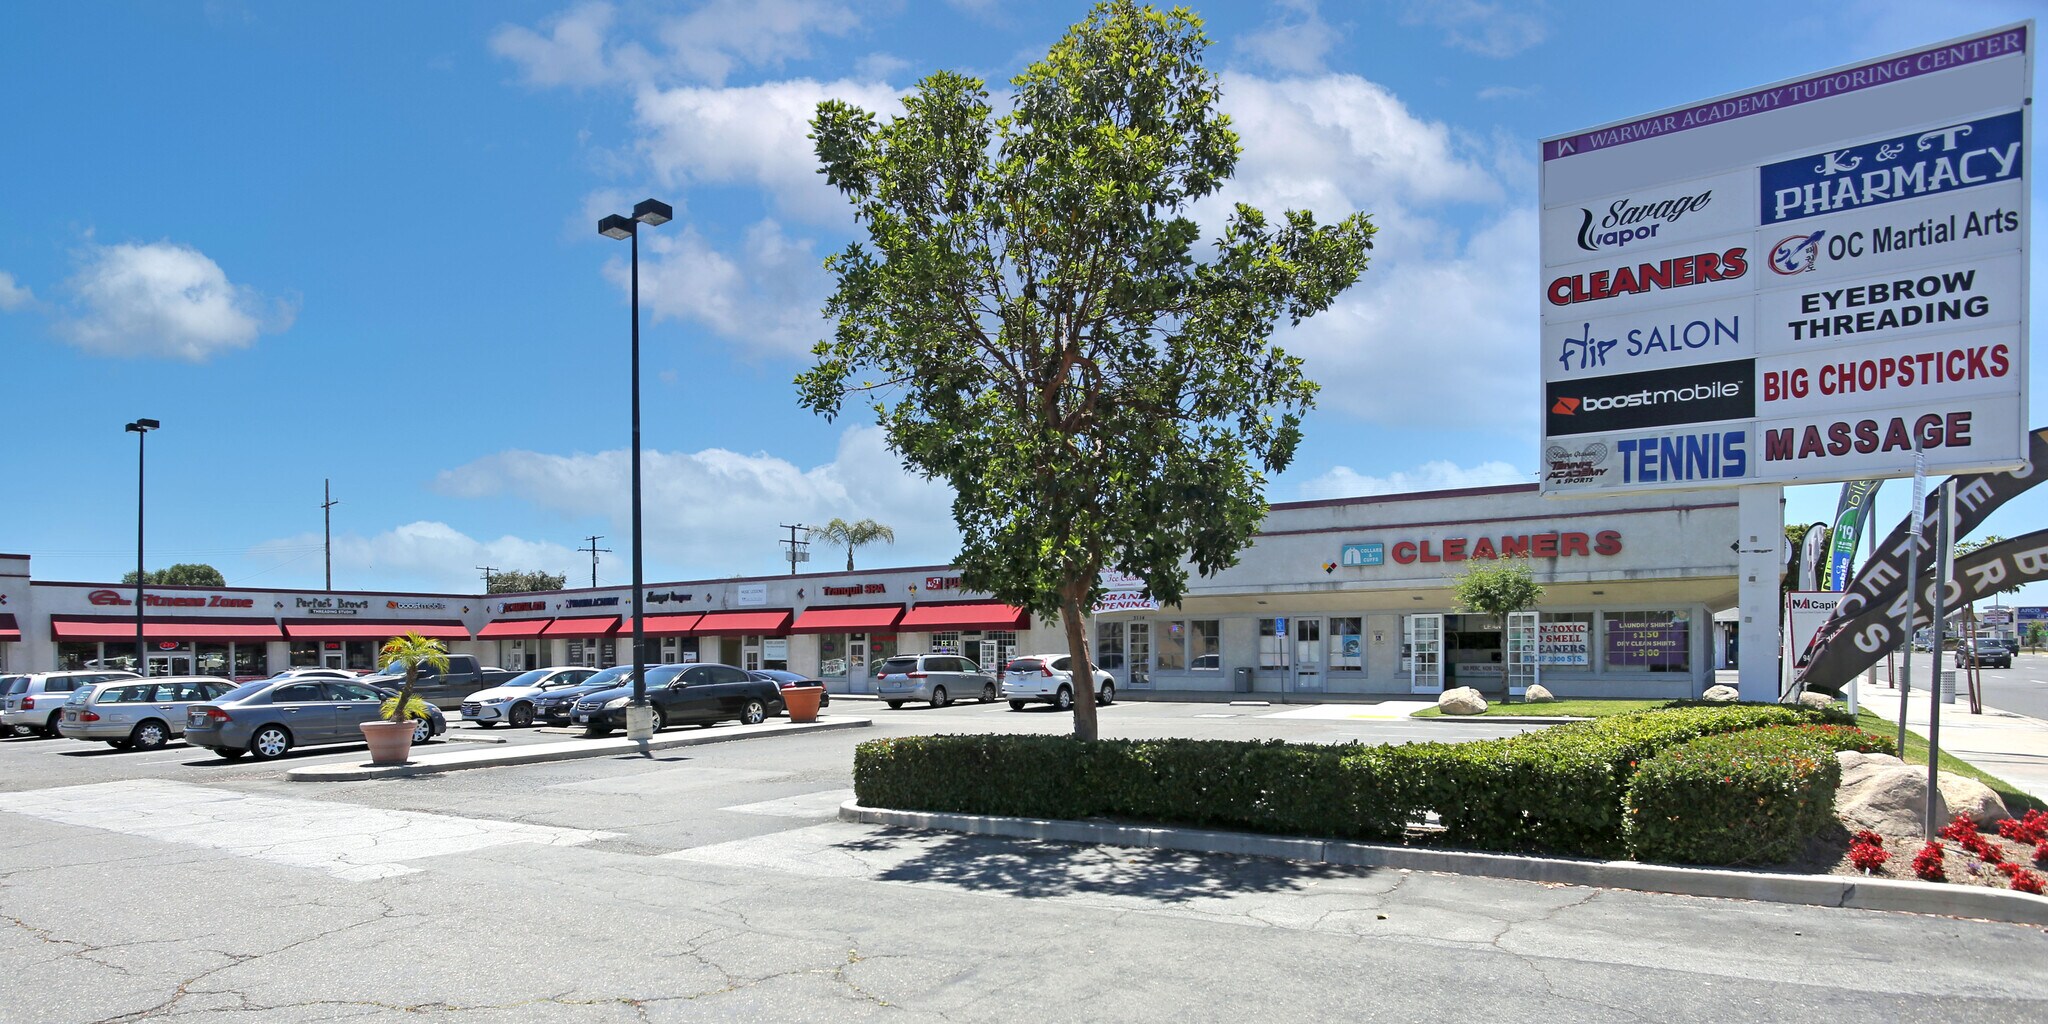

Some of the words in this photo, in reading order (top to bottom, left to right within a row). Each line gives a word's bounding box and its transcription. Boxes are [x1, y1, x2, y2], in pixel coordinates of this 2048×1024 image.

[1590, 117, 1676, 148] WARWAR
[1682, 90, 1783, 127] ACADEMY
[1789, 60, 1909, 101] TUTORING
[1917, 33, 2019, 71] CENTER
[1814, 150, 1862, 175] K
[1875, 143, 1904, 161] &
[1917, 125, 1972, 151] T
[1775, 142, 2021, 219] PHARMACY
[1602, 190, 1712, 228] Savage
[1829, 231, 1864, 261] OC
[1873, 215, 1955, 253] Martial
[1963, 208, 2019, 238] Arts
[1547, 247, 1748, 306] CLEANERS
[1802, 270, 1976, 314] EYEBROW
[1627, 316, 1739, 356] SALON
[1788, 296, 1989, 340] THREADING
[1764, 368, 1808, 401] BIG
[1819, 344, 2009, 395] CHOPSTICKS
[1618, 431, 1746, 484] TENNIS
[1765, 411, 1972, 461] MASSAGE
[1546, 468, 1608, 481] ACADEMY
[1551, 461, 1593, 470] TENNIS
[1392, 530, 1623, 564] CLEANERS
[208, 595, 254, 607] Zone
[864, 583, 886, 594] SPA
[1793, 598, 1810, 609] NAI
